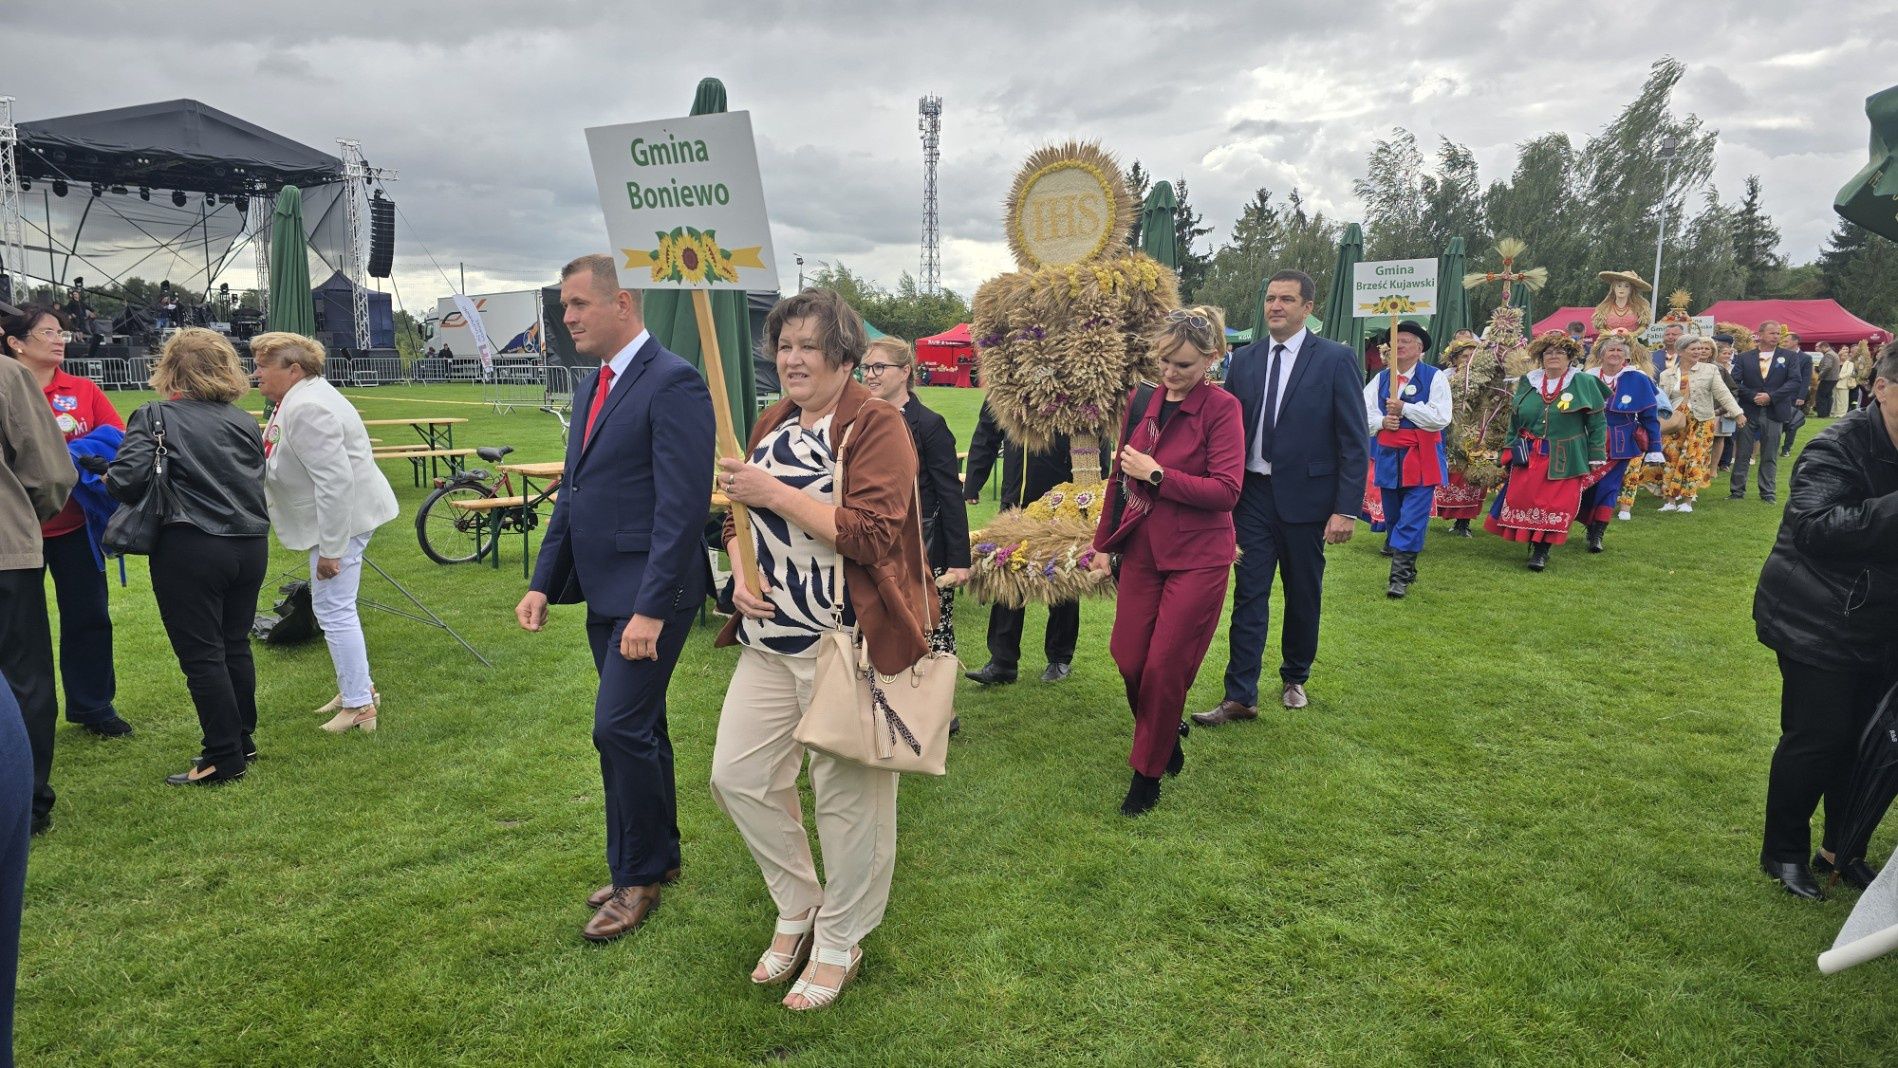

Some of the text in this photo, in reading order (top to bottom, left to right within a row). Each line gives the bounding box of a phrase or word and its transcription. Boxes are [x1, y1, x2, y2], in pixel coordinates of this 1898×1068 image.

[631, 133, 709, 167] Gmina
[626, 177, 730, 210] Boniewo
[1033, 191, 1099, 242] IHS
[1356, 277, 1435, 291] Brześć Kujawski
[1375, 264, 1415, 276] Gmina
